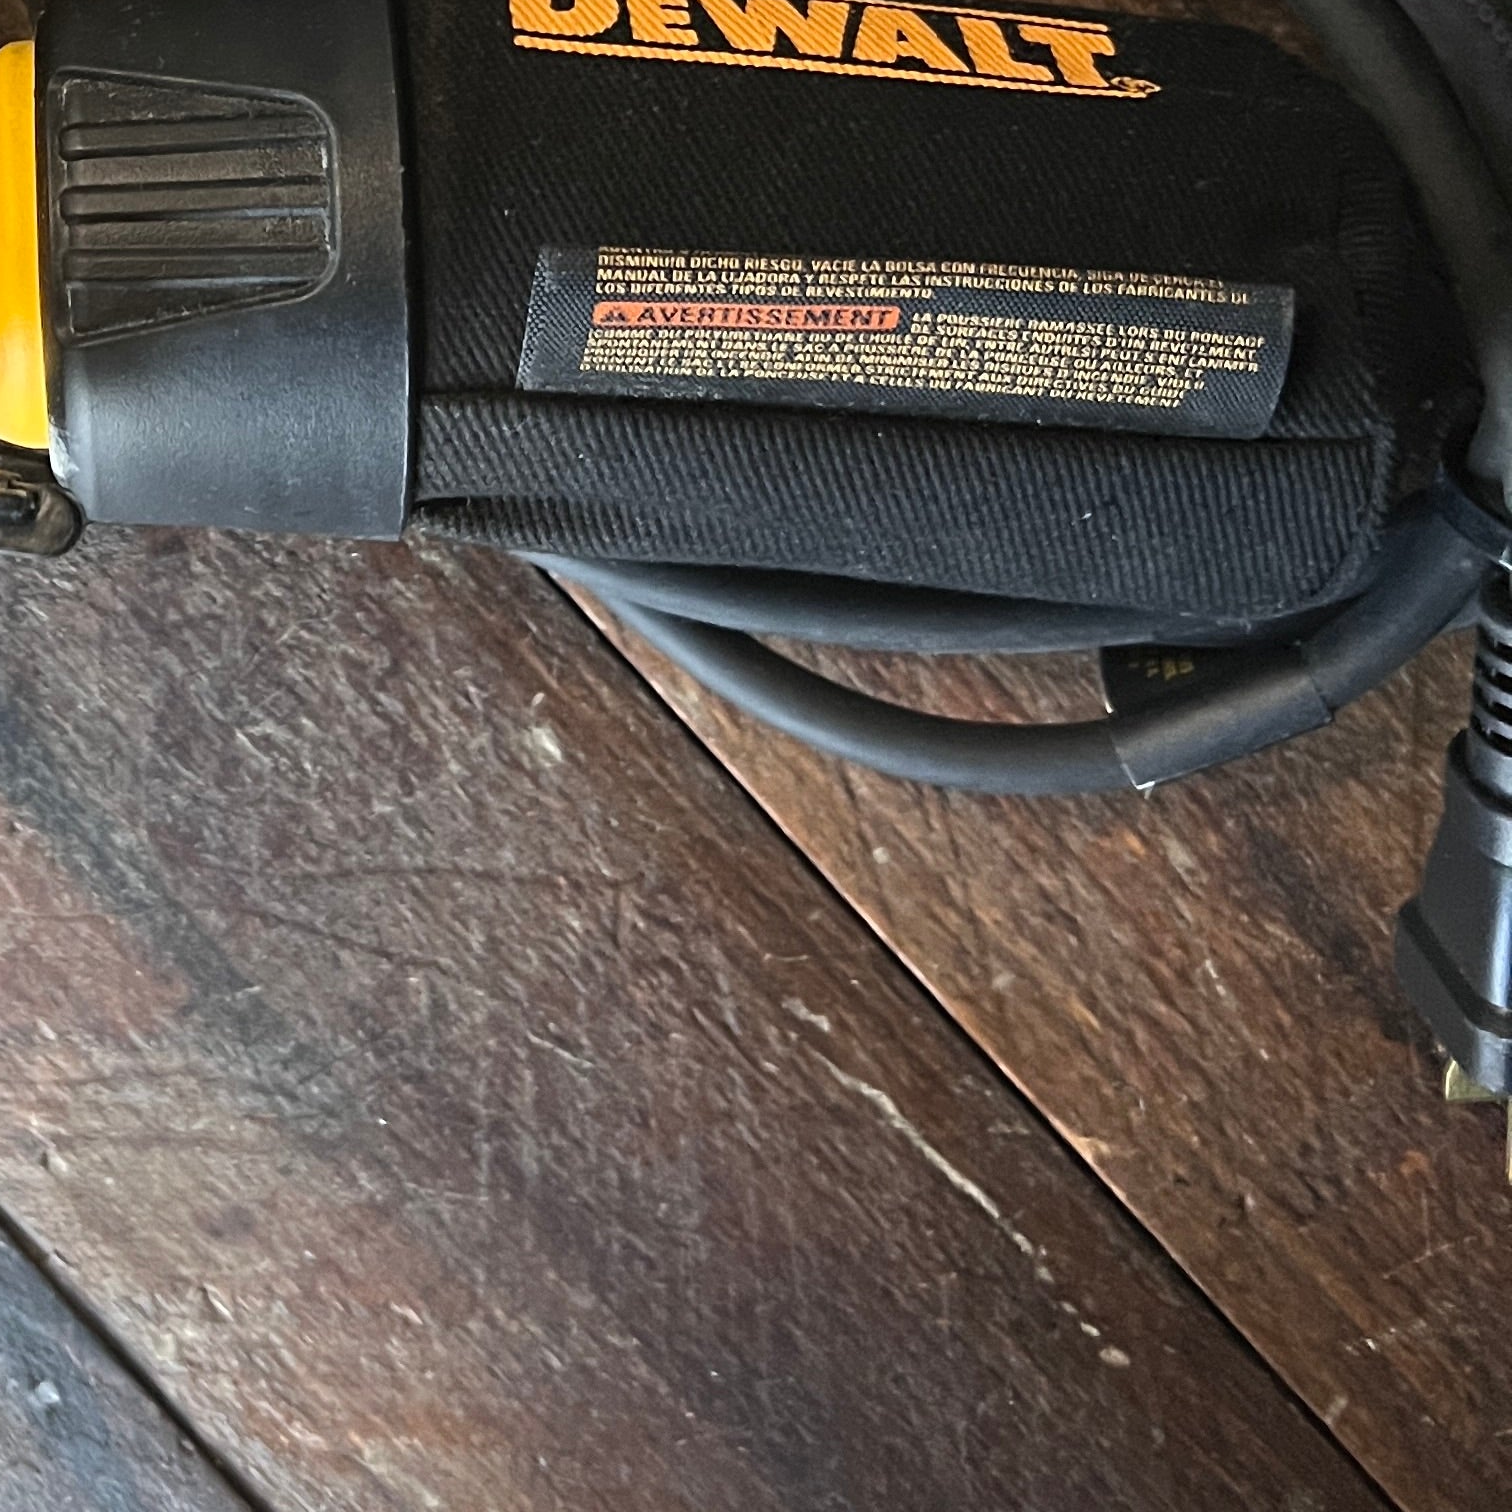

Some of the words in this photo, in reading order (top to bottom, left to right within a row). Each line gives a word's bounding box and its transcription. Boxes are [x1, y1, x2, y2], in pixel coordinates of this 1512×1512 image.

[690, 256, 739, 269] DICHO
[861, 260, 881, 273] LA
[885, 260, 936, 273] BOLSA
[941, 261, 976, 274] CON
[596, 268, 668, 282] MANUAL
[672, 270, 693, 283] DE
[697, 270, 717, 283] LA
[804, 273, 814, 284] Y
[891, 274, 921, 286] LAS
[731, 284, 777, 296] TIPOS
[637, 306, 893, 327] AVERTISSEMENT
